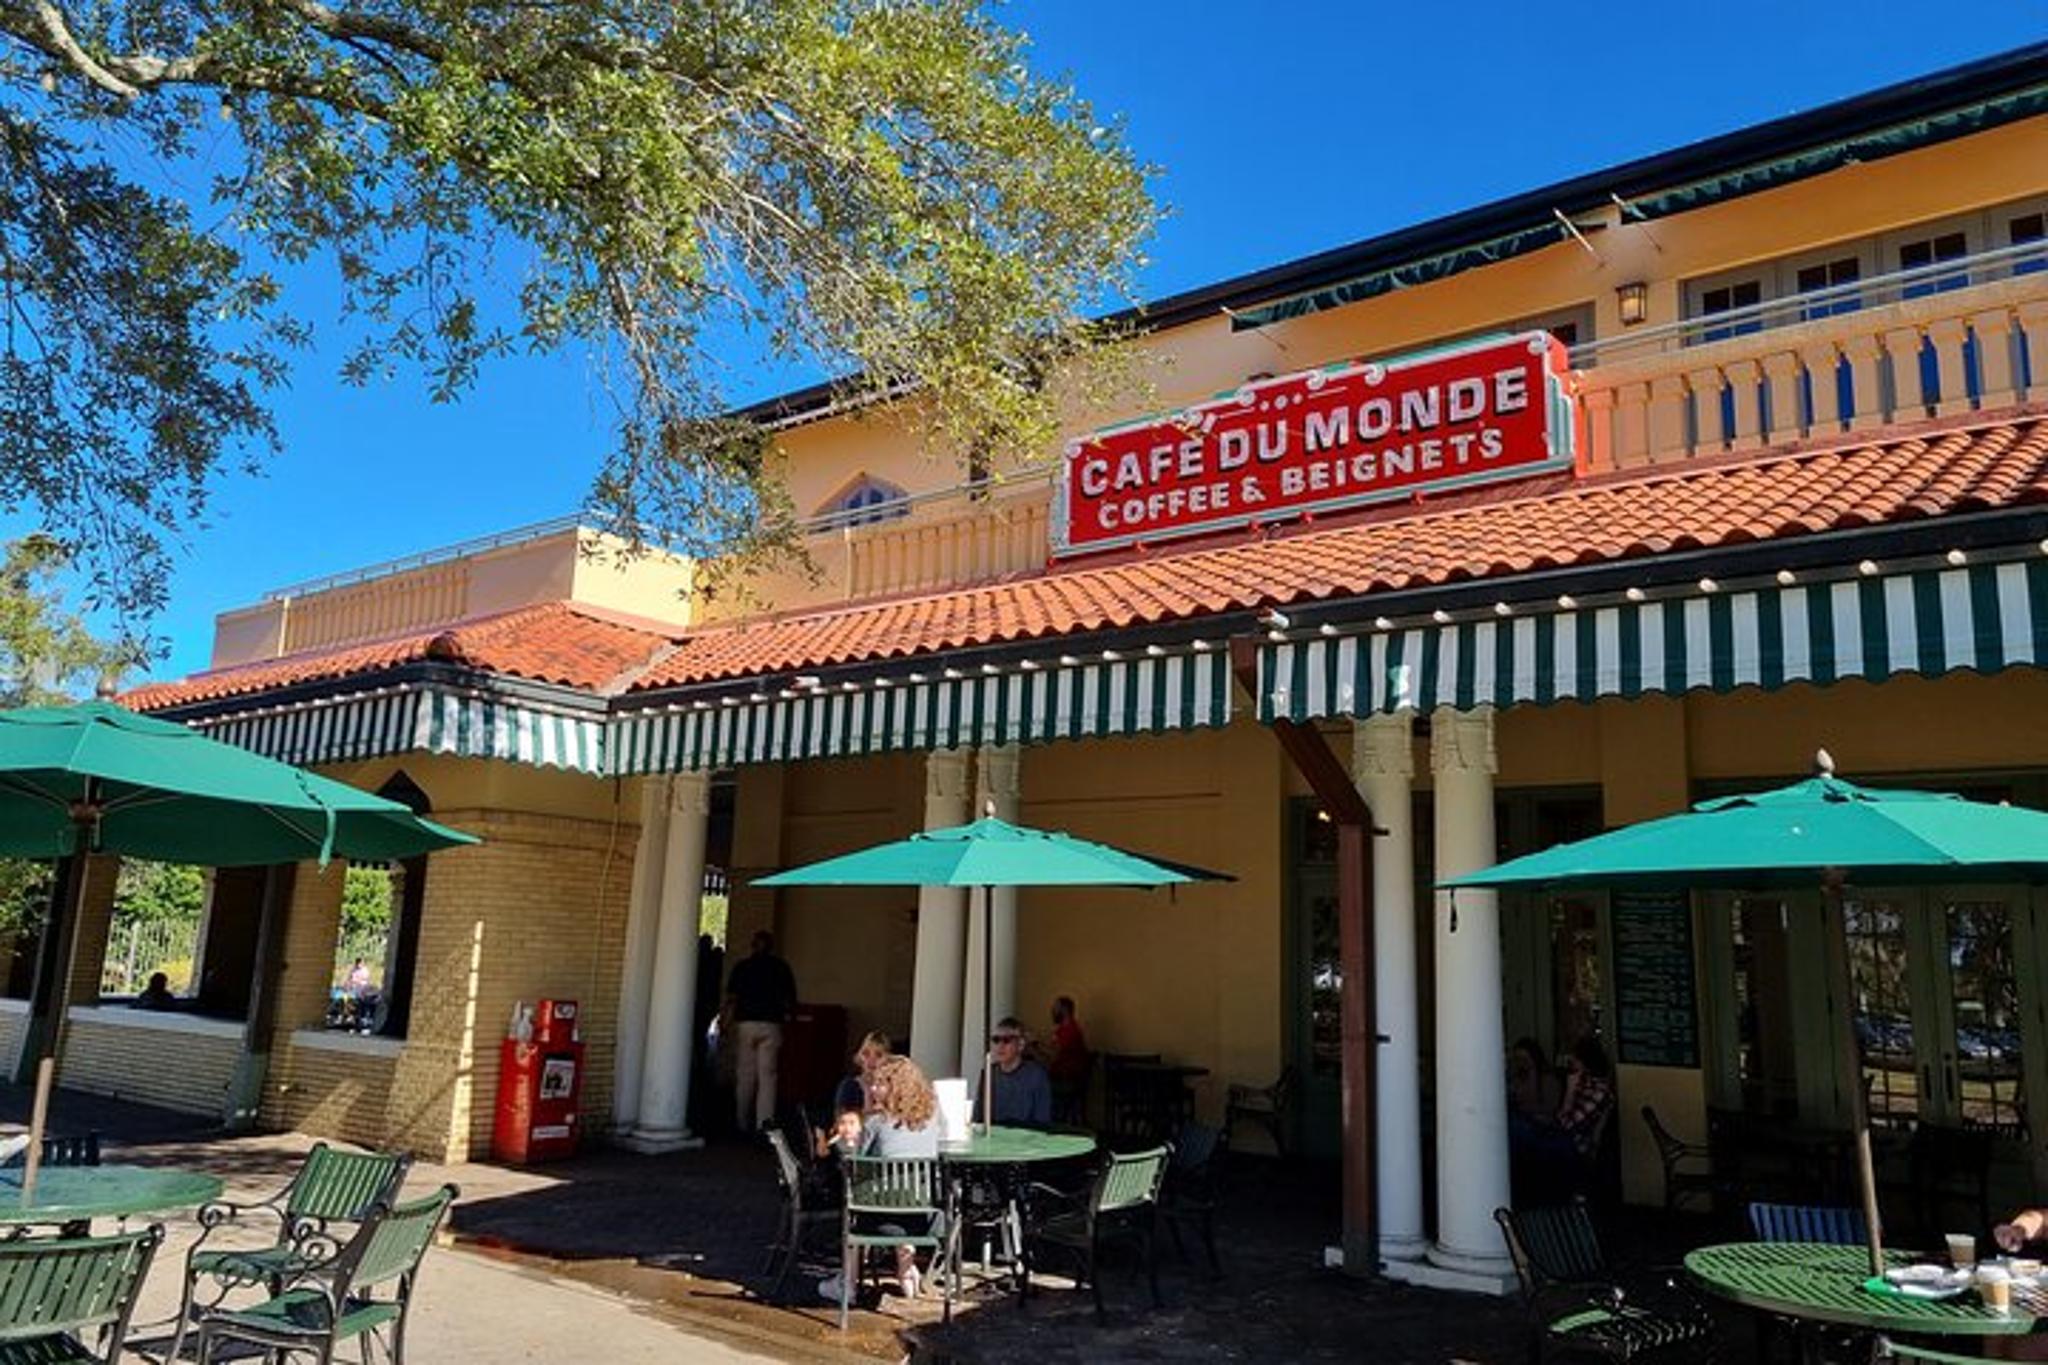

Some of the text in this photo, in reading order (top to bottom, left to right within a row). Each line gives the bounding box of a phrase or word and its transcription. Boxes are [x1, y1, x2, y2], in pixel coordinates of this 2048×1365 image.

[1218, 419, 1288, 470] DU
[1304, 366, 1529, 452] MONDE
[1098, 428, 1504, 530] COFFEE & BEIGNETS
